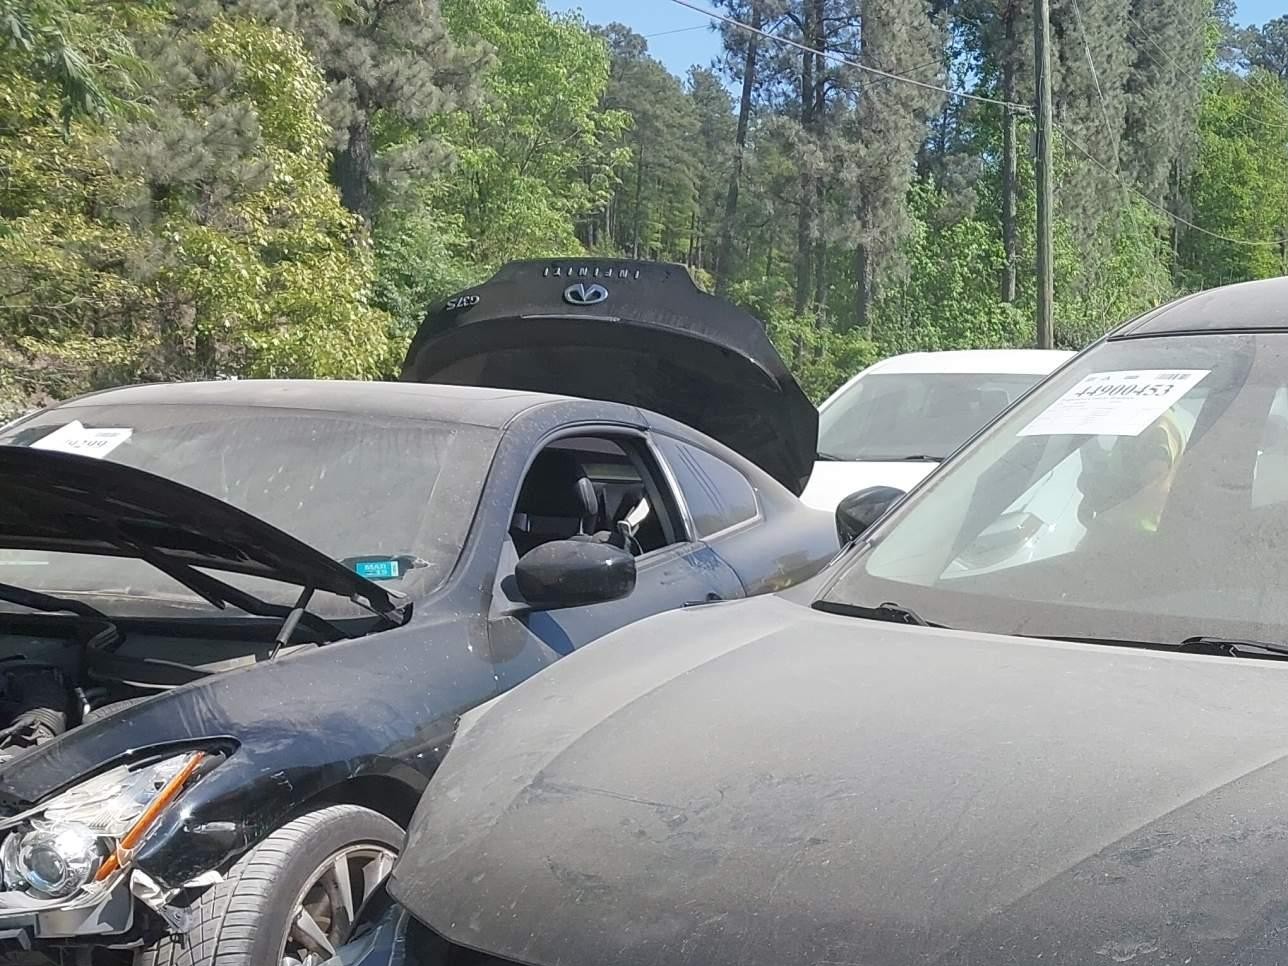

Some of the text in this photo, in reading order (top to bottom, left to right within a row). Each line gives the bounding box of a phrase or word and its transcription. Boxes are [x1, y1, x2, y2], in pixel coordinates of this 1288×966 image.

[543, 267, 640, 279] INFINITI
[446, 295, 480, 310] G37S
[1075, 383, 1174, 397] 44900453
